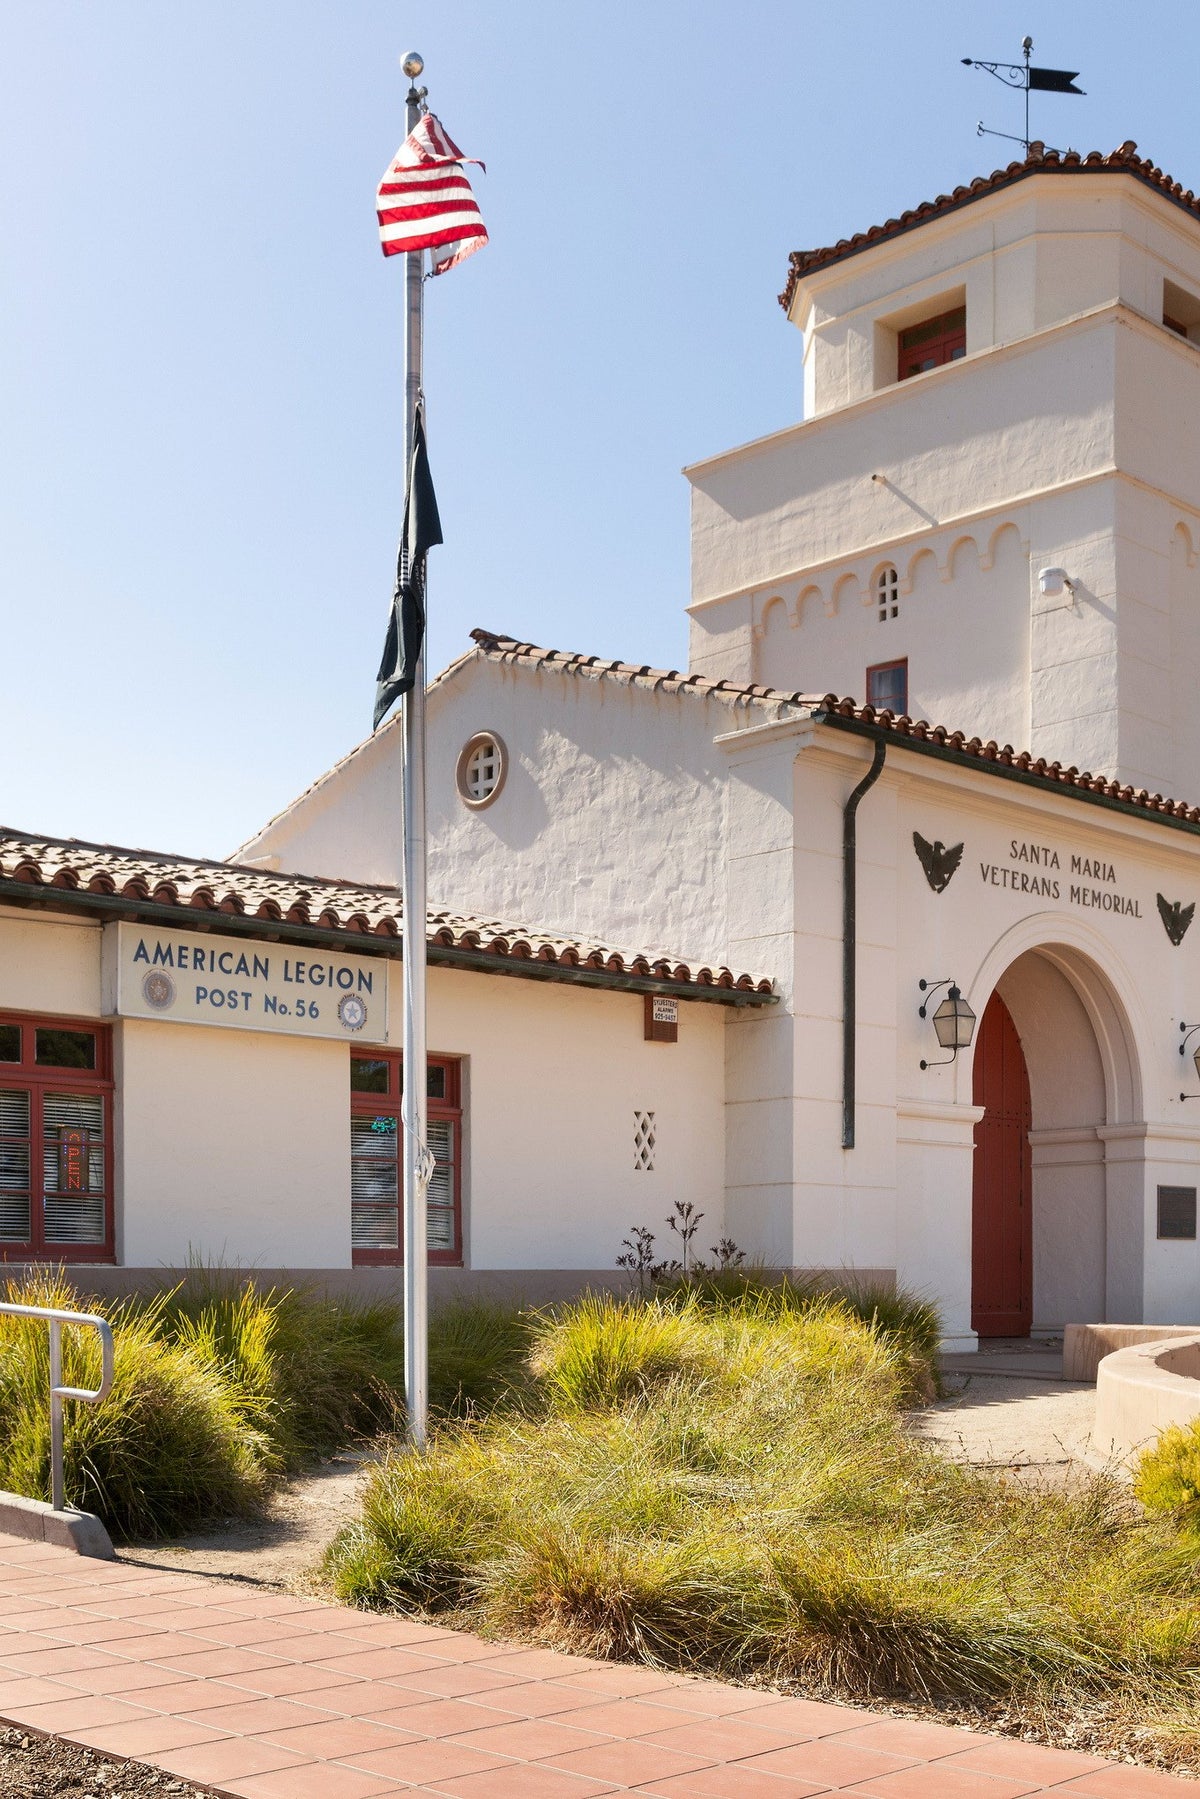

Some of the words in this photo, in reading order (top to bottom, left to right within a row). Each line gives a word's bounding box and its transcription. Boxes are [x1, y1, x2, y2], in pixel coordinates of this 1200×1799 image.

[1010, 840, 1060, 869] SANTA
[1071, 854, 1116, 883] MARIA
[980, 863, 1060, 900] VETERANS
[1070, 885, 1142, 919] MEMORIAL
[132, 938, 269, 982] AMERICAN
[283, 959, 373, 995] LEGION
[195, 986, 252, 1011] POST
